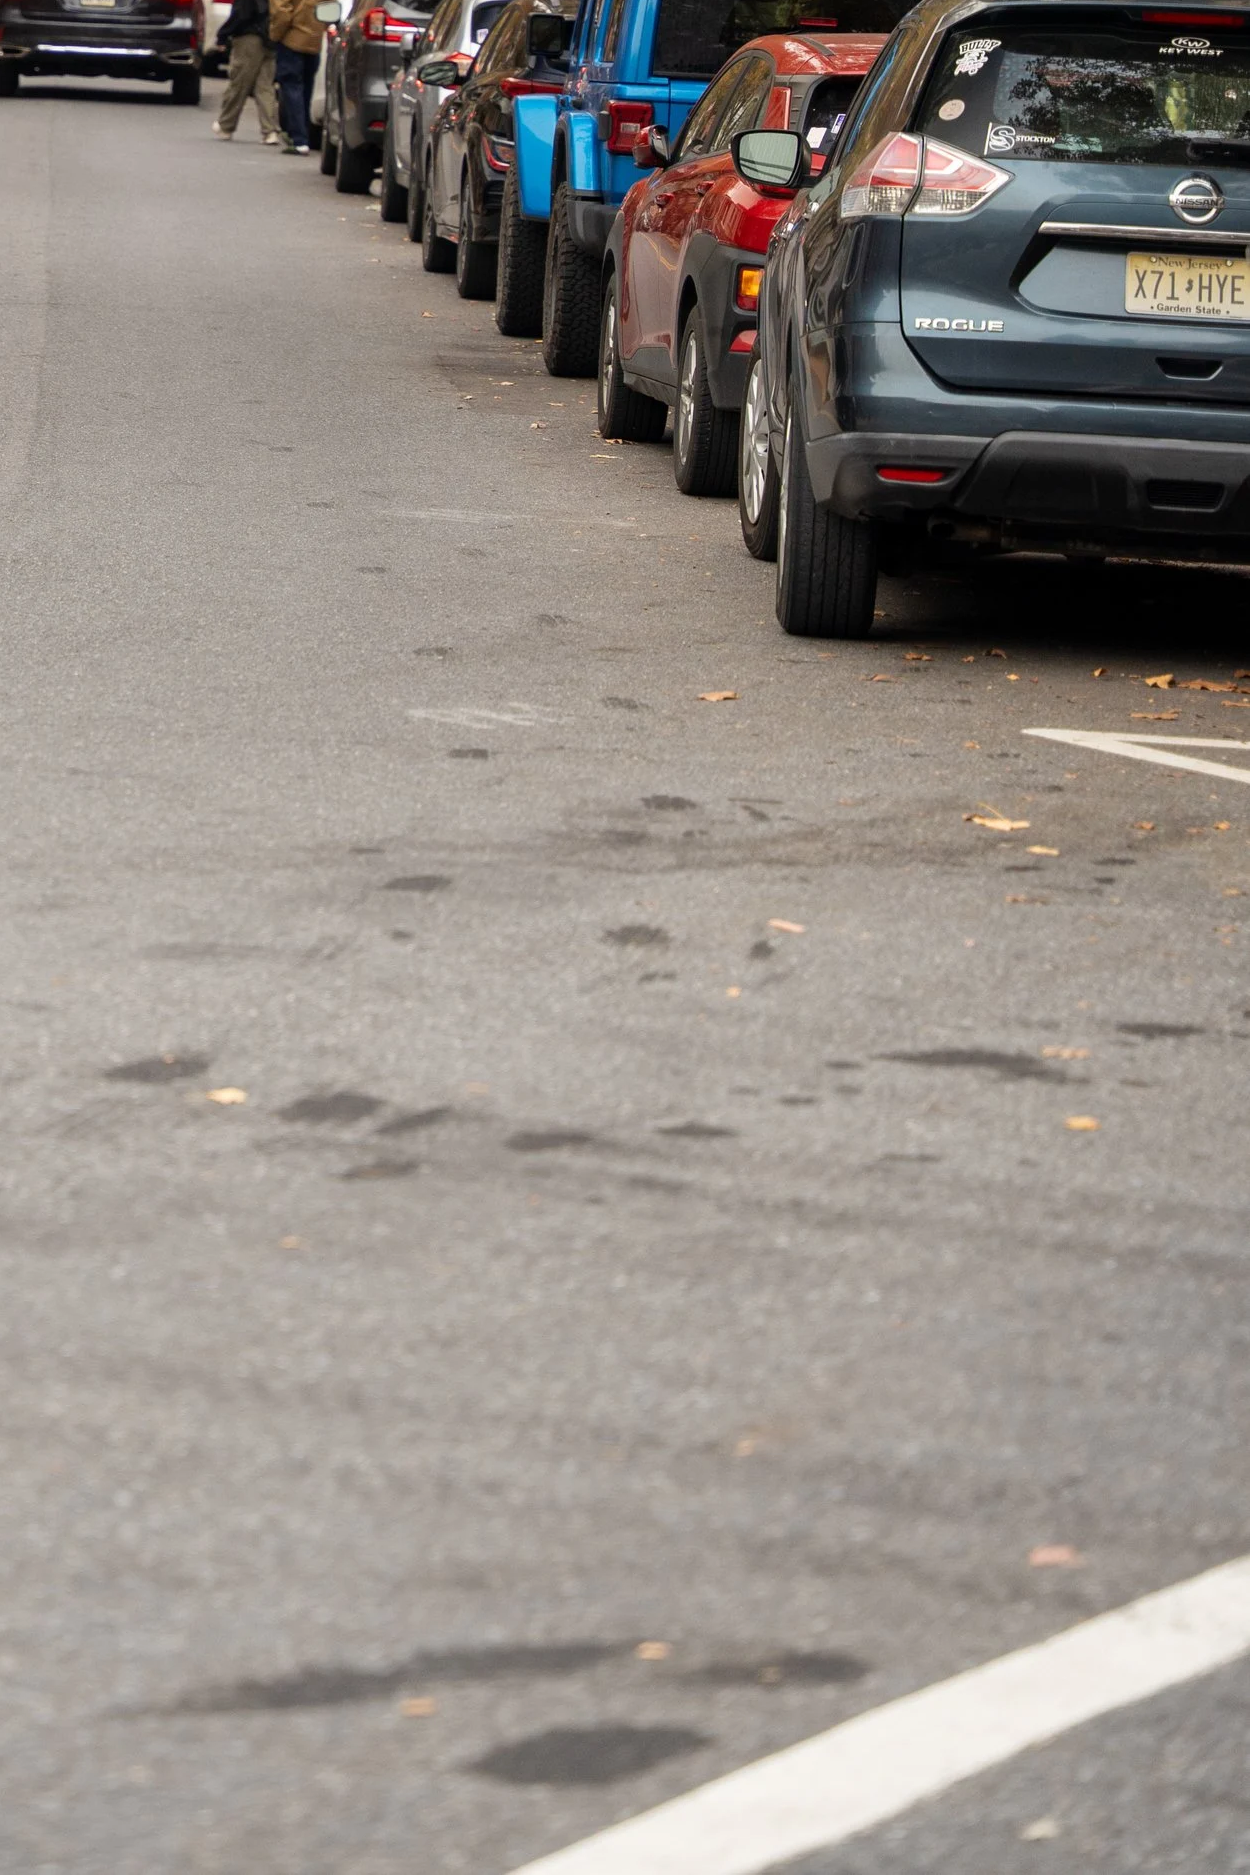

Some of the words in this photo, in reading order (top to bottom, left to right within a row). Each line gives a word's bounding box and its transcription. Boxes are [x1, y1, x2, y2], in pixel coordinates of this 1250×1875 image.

[960, 39, 1001, 54] BULLY
[1177, 37, 1204, 47] KW
[1187, 48, 1224, 56] WEST
[1015, 135, 1056, 144] STOCKTON
[1175, 198, 1218, 206] NISSAN
[1158, 256, 1186, 268] New
[1187, 258, 1225, 270] Jersey
[1134, 269, 1180, 301] X71
[1198, 273, 1245, 305] HYE
[1156, 303, 1192, 313] Garden
[1195, 305, 1222, 315] State
[914, 317, 1005, 333] ROGUE
